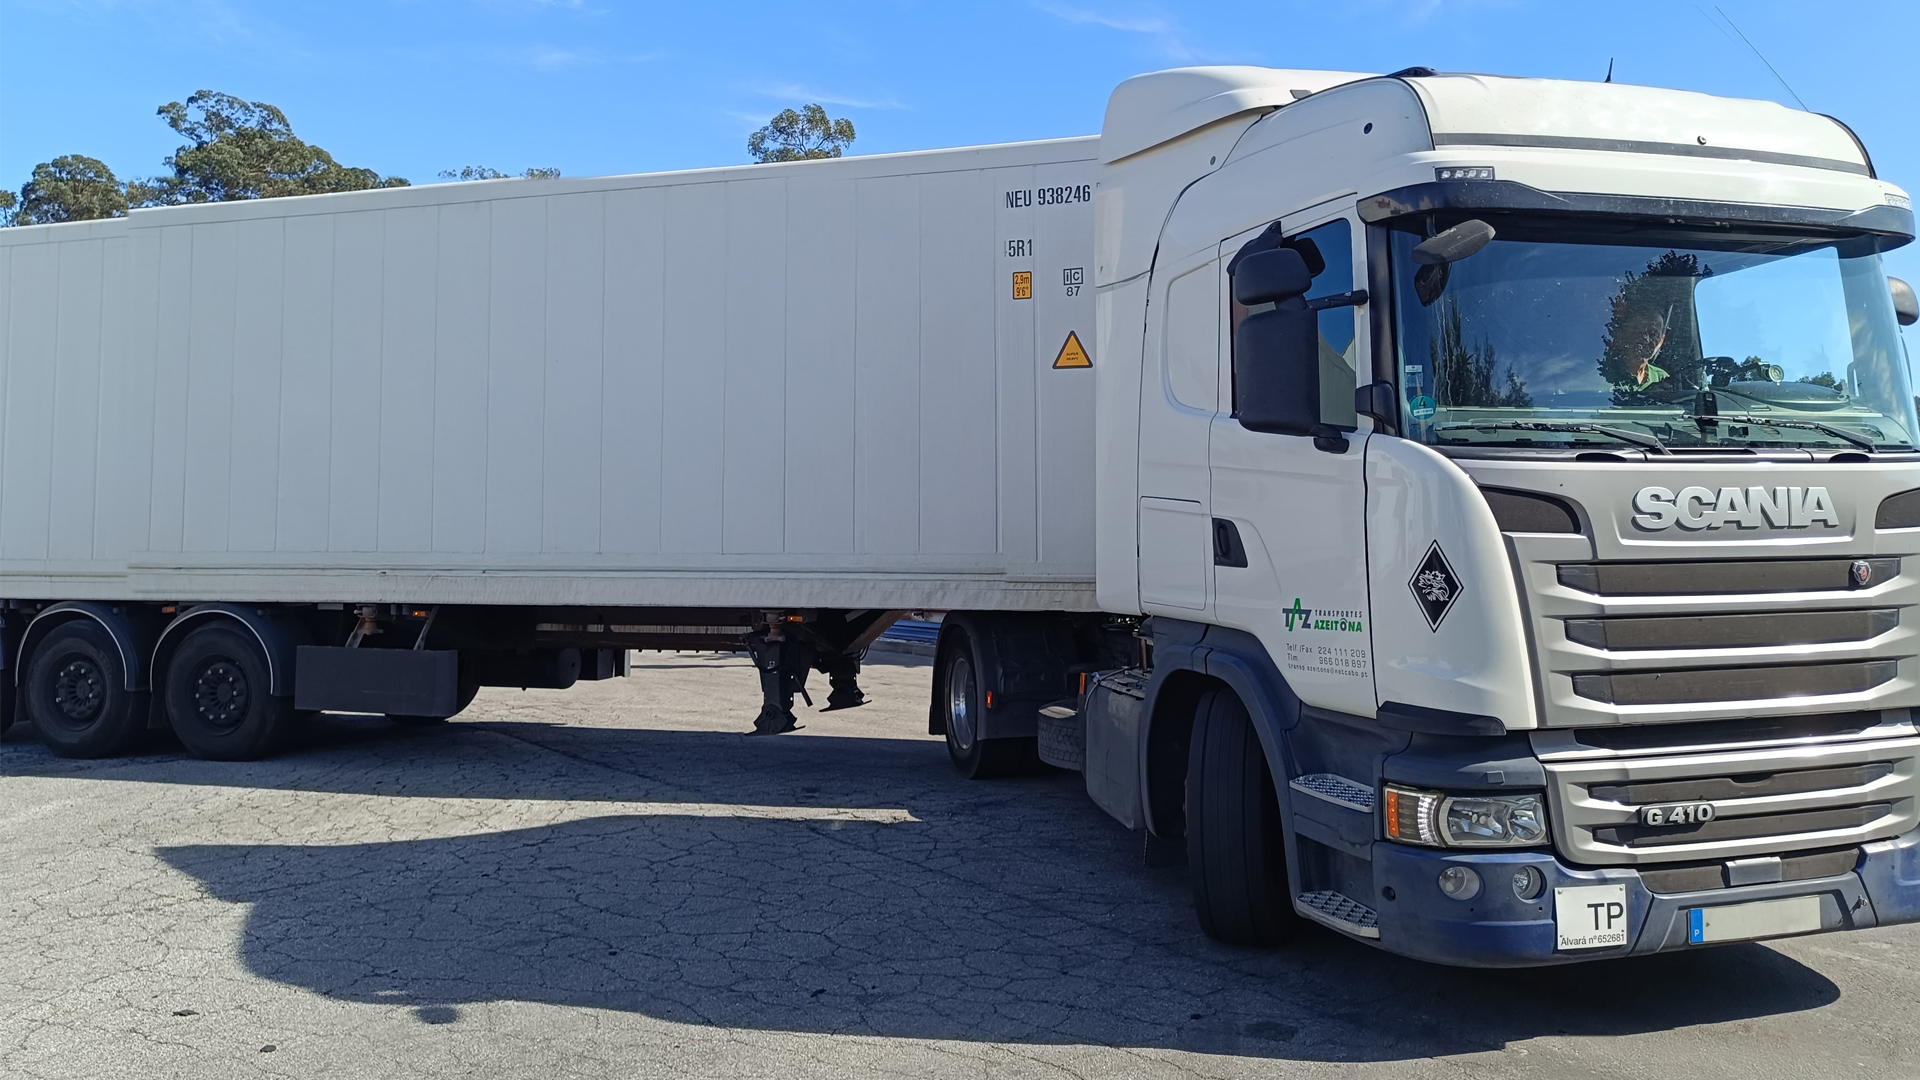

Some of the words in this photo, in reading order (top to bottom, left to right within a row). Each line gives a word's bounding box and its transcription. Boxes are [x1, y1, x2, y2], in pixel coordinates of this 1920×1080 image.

[1005, 189, 1032, 209] NEU
[1037, 184, 1091, 206] 938246
[1066, 286, 1081, 297] 87
[1418, 396, 1426, 408] 4
[1631, 486, 1840, 533] SCANIA
[1314, 609, 1362, 618] TRANSPORTES
[1317, 646, 1332, 655] 224
[1334, 648, 1348, 657] 111
[1350, 649, 1366, 659] 209
[1318, 656, 1333, 666] 966
[1334, 658, 1350, 668] 018
[1351, 659, 1367, 669] 897
[1647, 808, 1663, 826] G
[1669, 804, 1713, 824] 410
[1587, 902, 1624, 931] TP
[1560, 936, 1587, 946] Alvará
[1598, 933, 1625, 943] 652681
[1694, 929, 1700, 937] P
